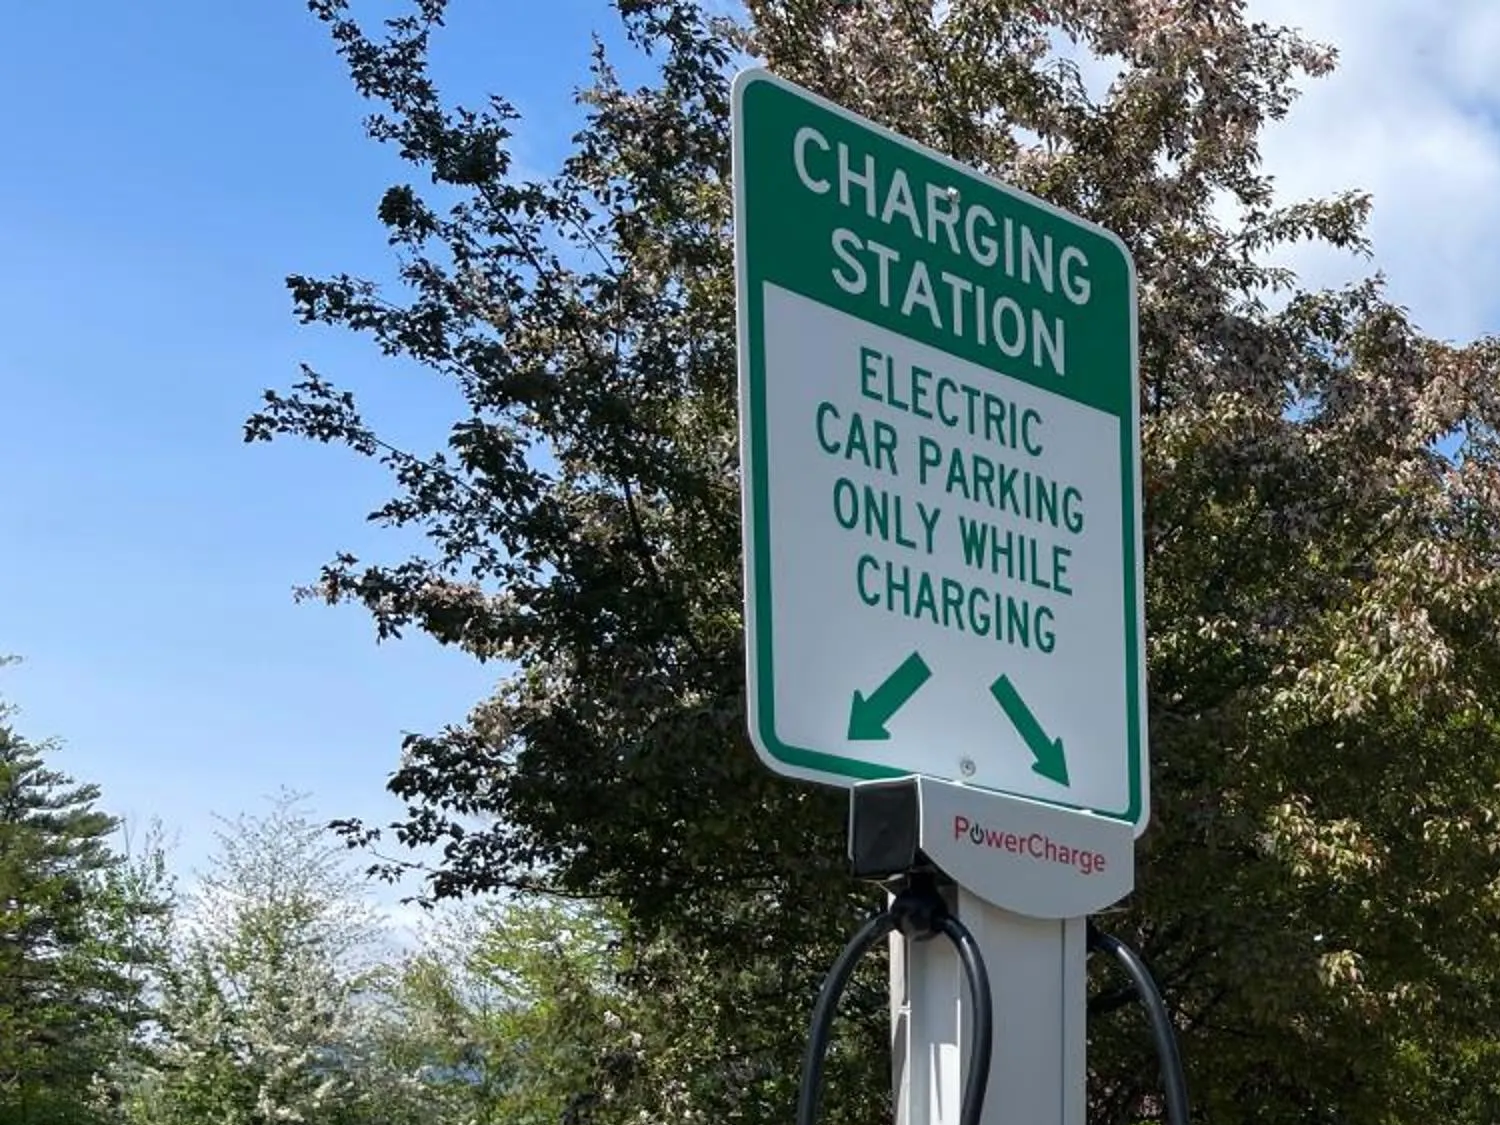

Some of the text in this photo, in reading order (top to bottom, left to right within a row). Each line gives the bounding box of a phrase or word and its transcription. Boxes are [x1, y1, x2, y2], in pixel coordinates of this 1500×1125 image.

[792, 126, 1092, 305] CHARGING
[830, 227, 1066, 377] STATION
[859, 345, 1044, 457] ELECTRIC
[815, 401, 1084, 535] CAR PARKING
[832, 476, 1074, 597] ONLY WHILE
[856, 553, 1057, 655] CHARGING
[954, 815, 1106, 875] PowerCharge
